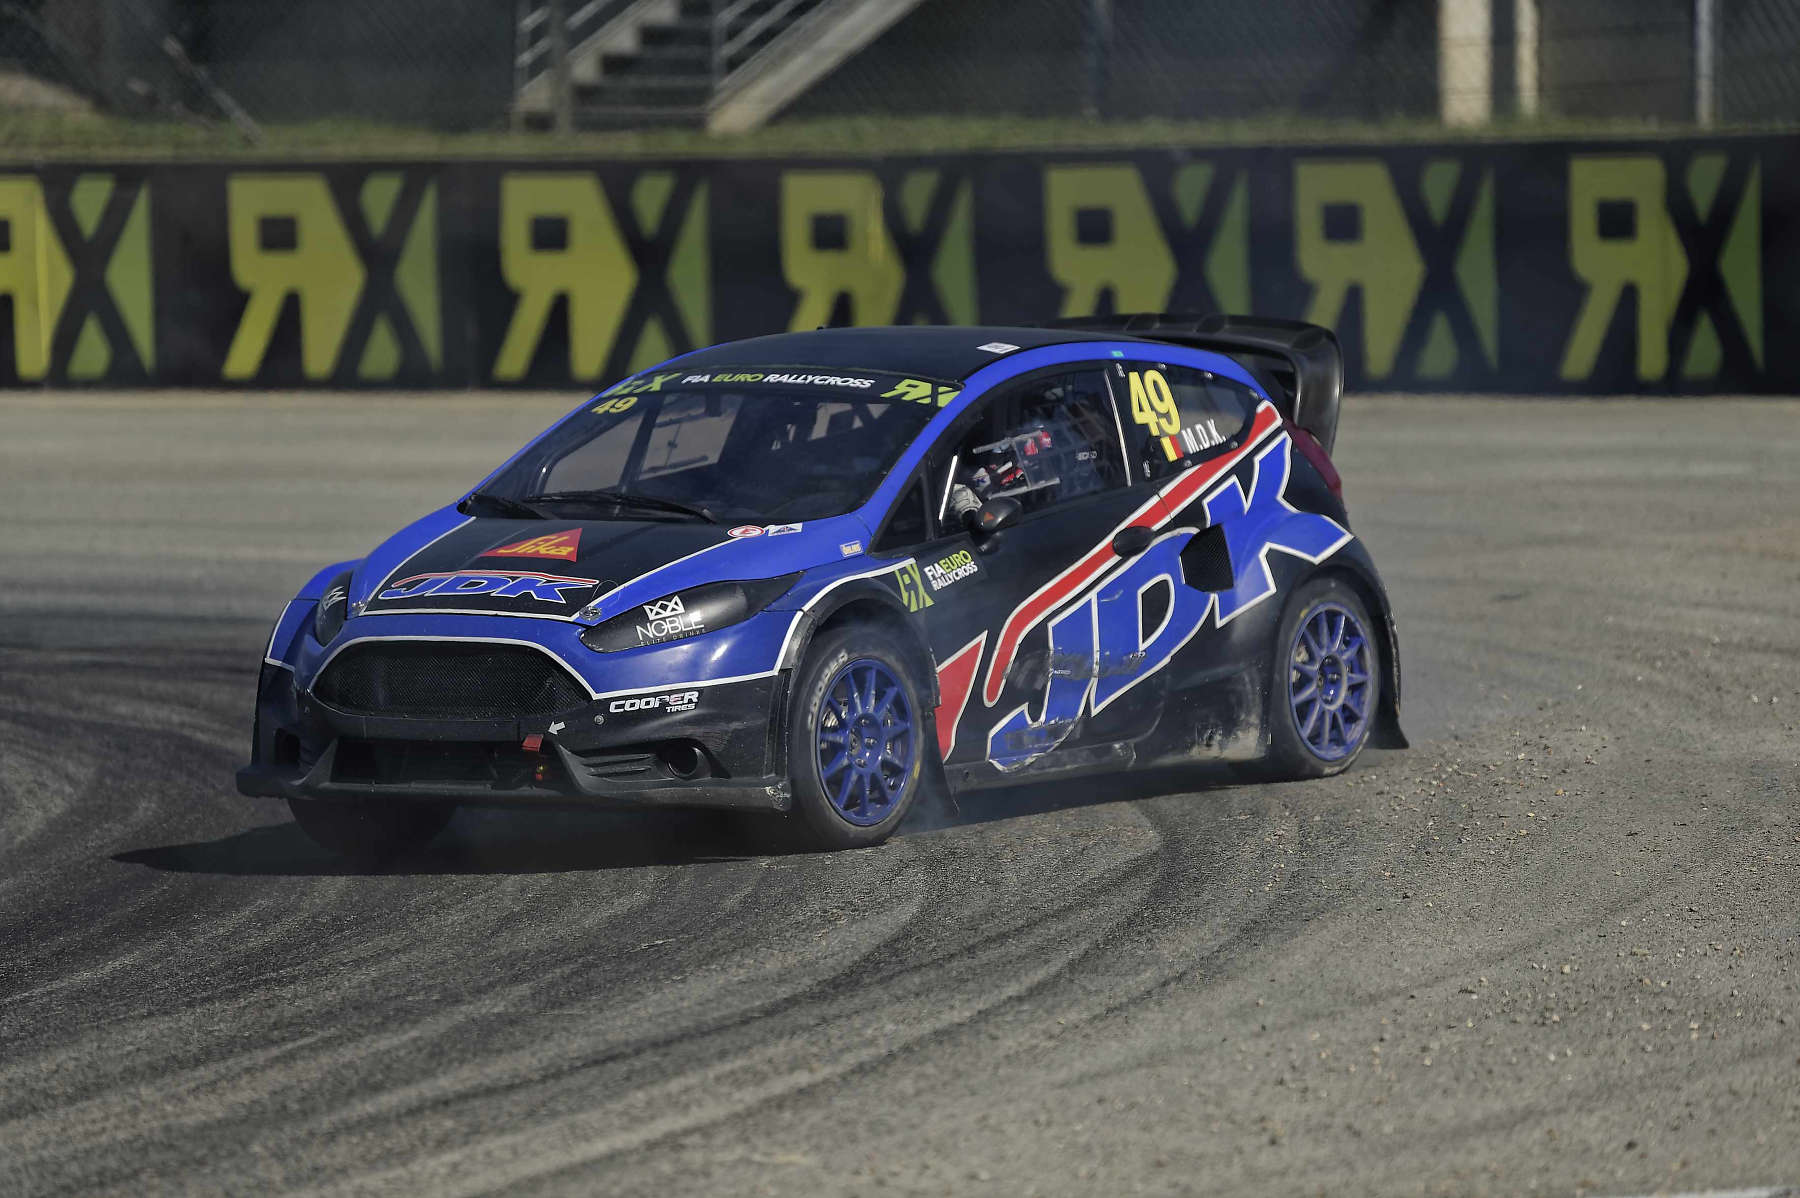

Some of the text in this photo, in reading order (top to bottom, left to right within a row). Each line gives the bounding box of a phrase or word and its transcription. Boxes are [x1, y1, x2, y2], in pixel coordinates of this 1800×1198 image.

[681, 373, 876, 389] FIA EURO RALLYCROSS
[591, 396, 638, 414] 49
[1128, 369, 1181, 437] 49
[1181, 418, 1227, 454] M.D.K.
[378, 575, 595, 604] JDK
[931, 561, 978, 591] RALLYCROSS
[986, 431, 1354, 773] JDK
[636, 611, 705, 640] NOBLE
[609, 691, 699, 713] COOPER
[665, 703, 696, 713] TIRES
